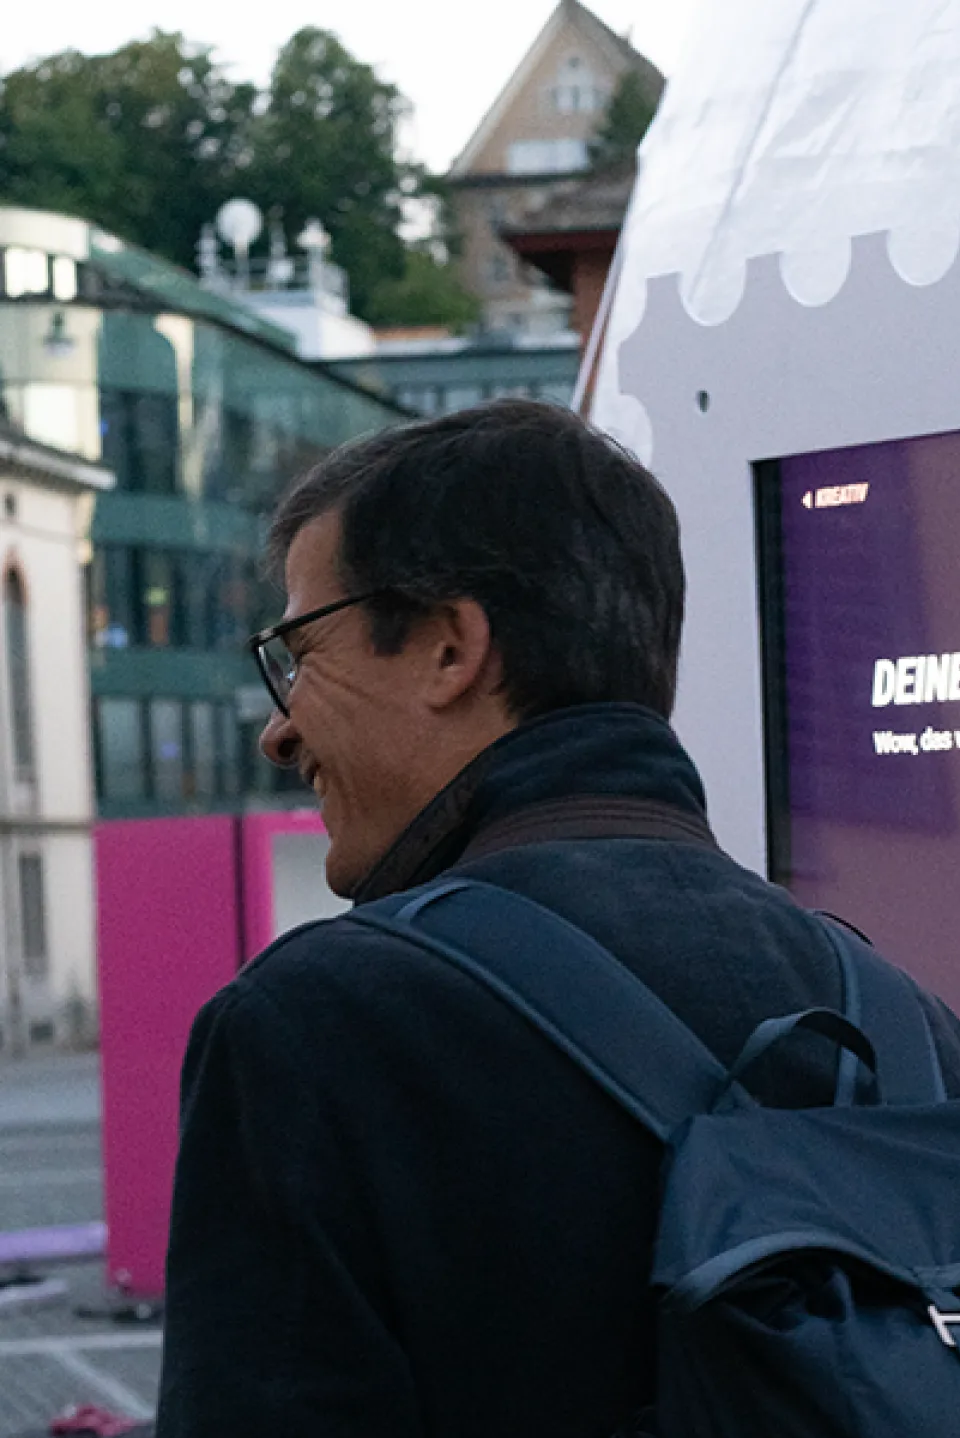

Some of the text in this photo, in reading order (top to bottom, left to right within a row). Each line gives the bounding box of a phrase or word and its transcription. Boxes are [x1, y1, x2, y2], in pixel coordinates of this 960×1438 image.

[815, 481, 868, 508] KREATIV
[872, 731, 919, 755] Wow,
[920, 726, 952, 751] das
